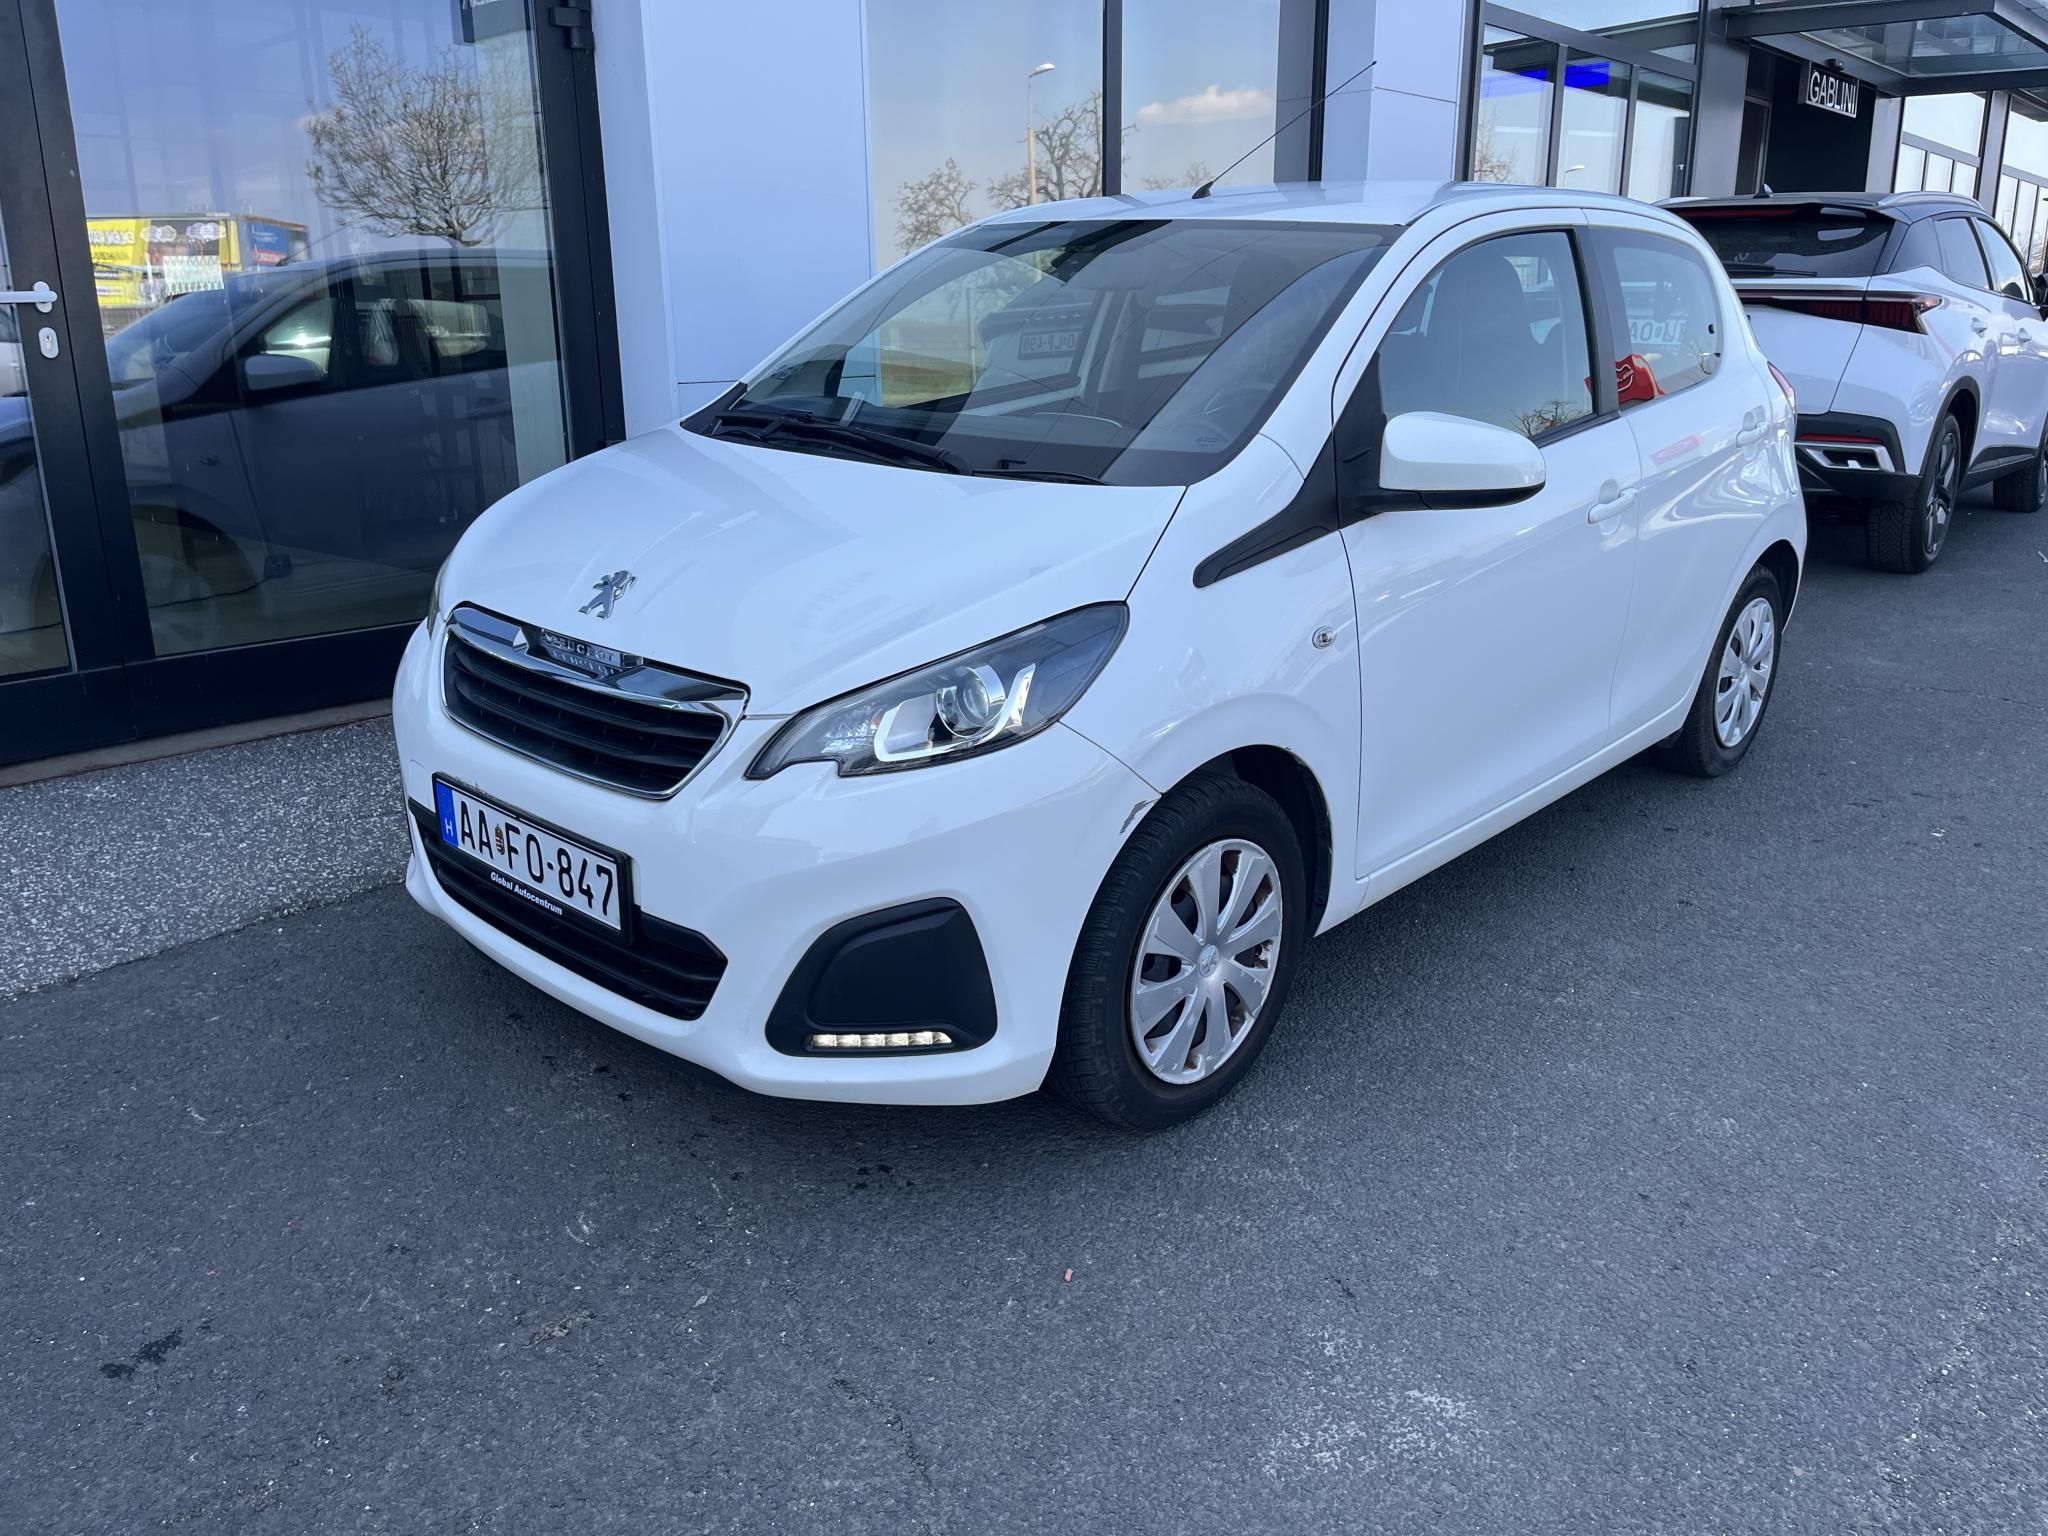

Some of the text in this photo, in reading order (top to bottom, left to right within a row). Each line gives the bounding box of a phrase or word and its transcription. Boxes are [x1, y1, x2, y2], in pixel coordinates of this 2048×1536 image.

[1809, 71, 1857, 114] GABLINI
[444, 818, 454, 838] H
[490, 871, 563, 916] Global Autocentrum
